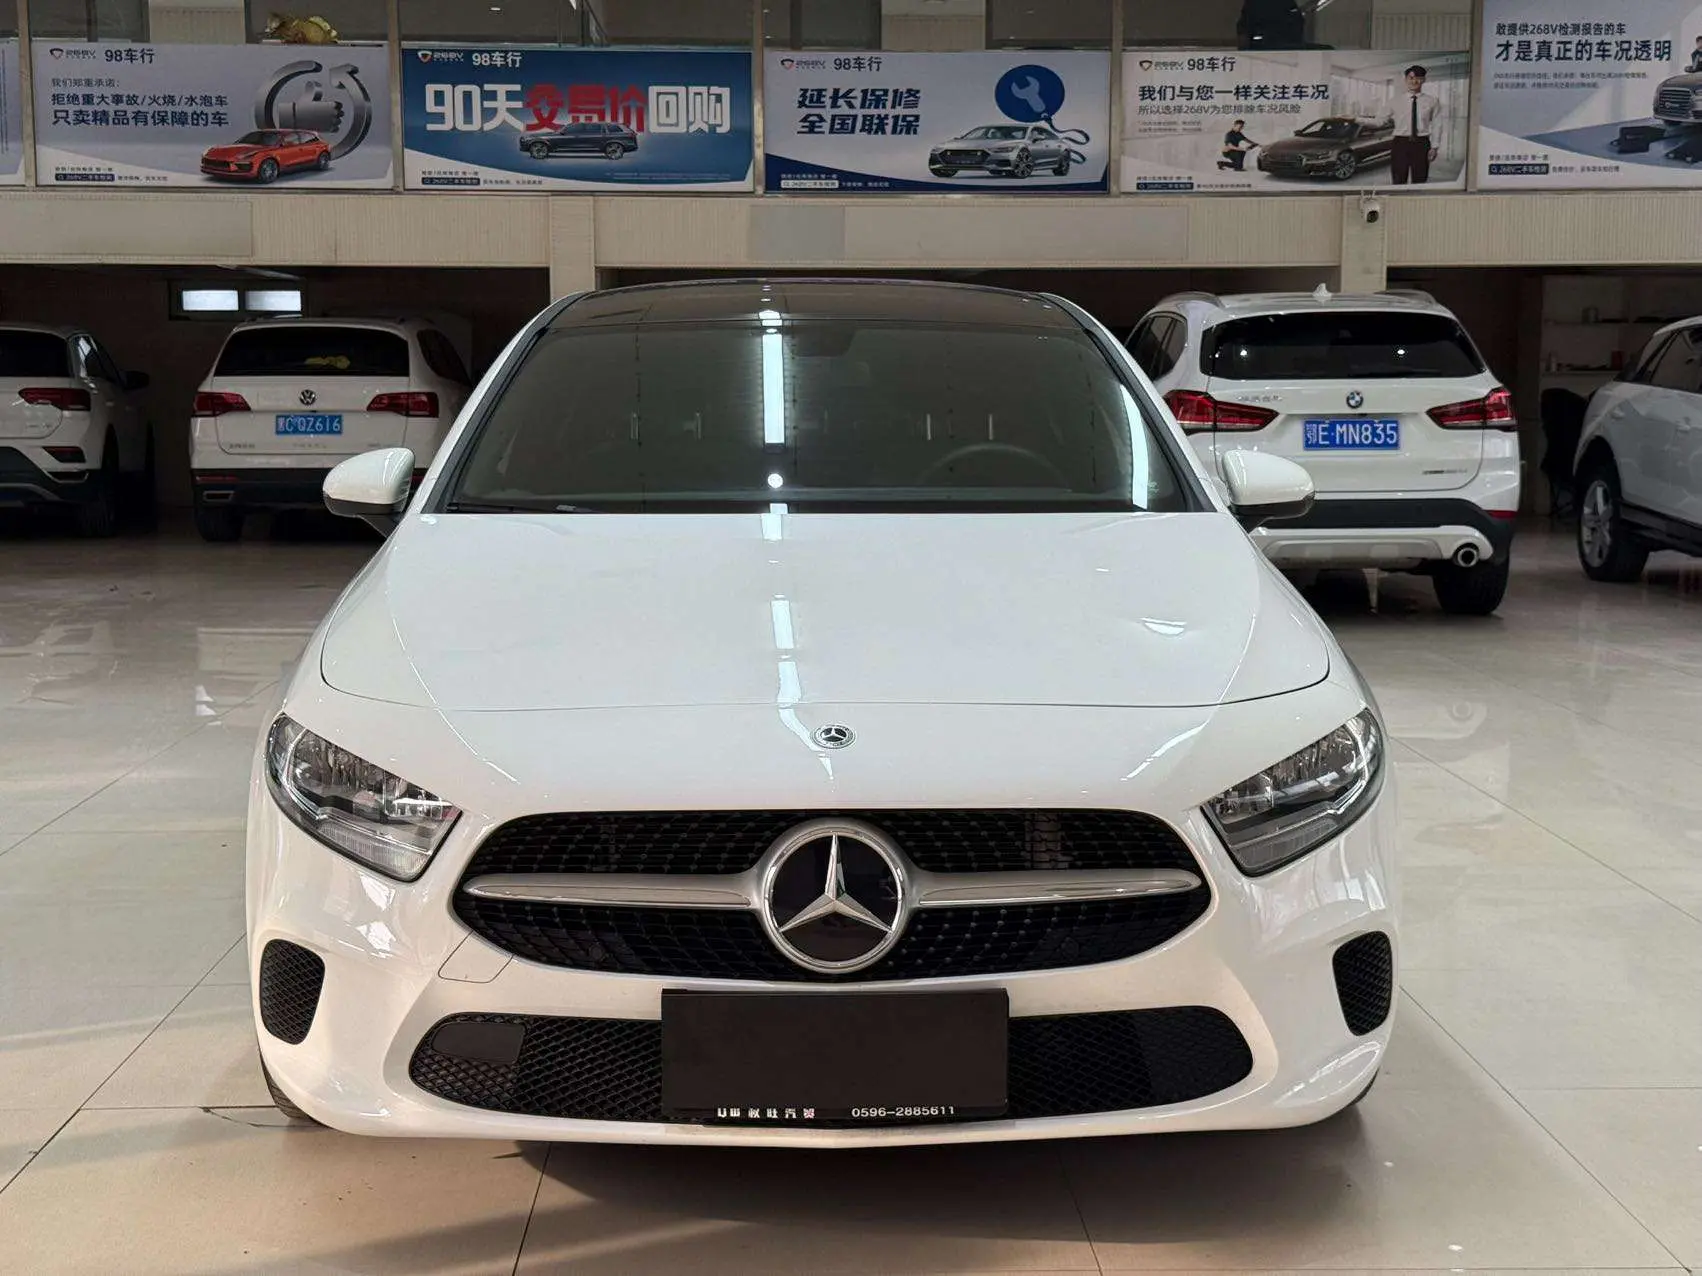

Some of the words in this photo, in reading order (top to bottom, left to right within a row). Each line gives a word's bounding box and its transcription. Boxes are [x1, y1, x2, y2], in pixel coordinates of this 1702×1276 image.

[1495, 22, 1627, 36] 敢提供268V检测报告的车
[104, 48, 156, 64] 98车行
[1495, 39, 1672, 62] 才是真正的车况透明
[472, 51, 522, 68] 98车行
[833, 56, 883, 72] 98车行
[1187, 57, 1236, 72] 98车行
[51, 93, 229, 108] 拒绝重大事故/火烧/水泡车
[797, 87, 922, 110] 延长保修
[1138, 84, 1330, 101] 我们与您一样关注车况
[51, 109, 229, 128] 只卖精品有保障的车
[796, 113, 921, 136] 全国联保
[851, 1105, 955, 1118] 0596-2885611
